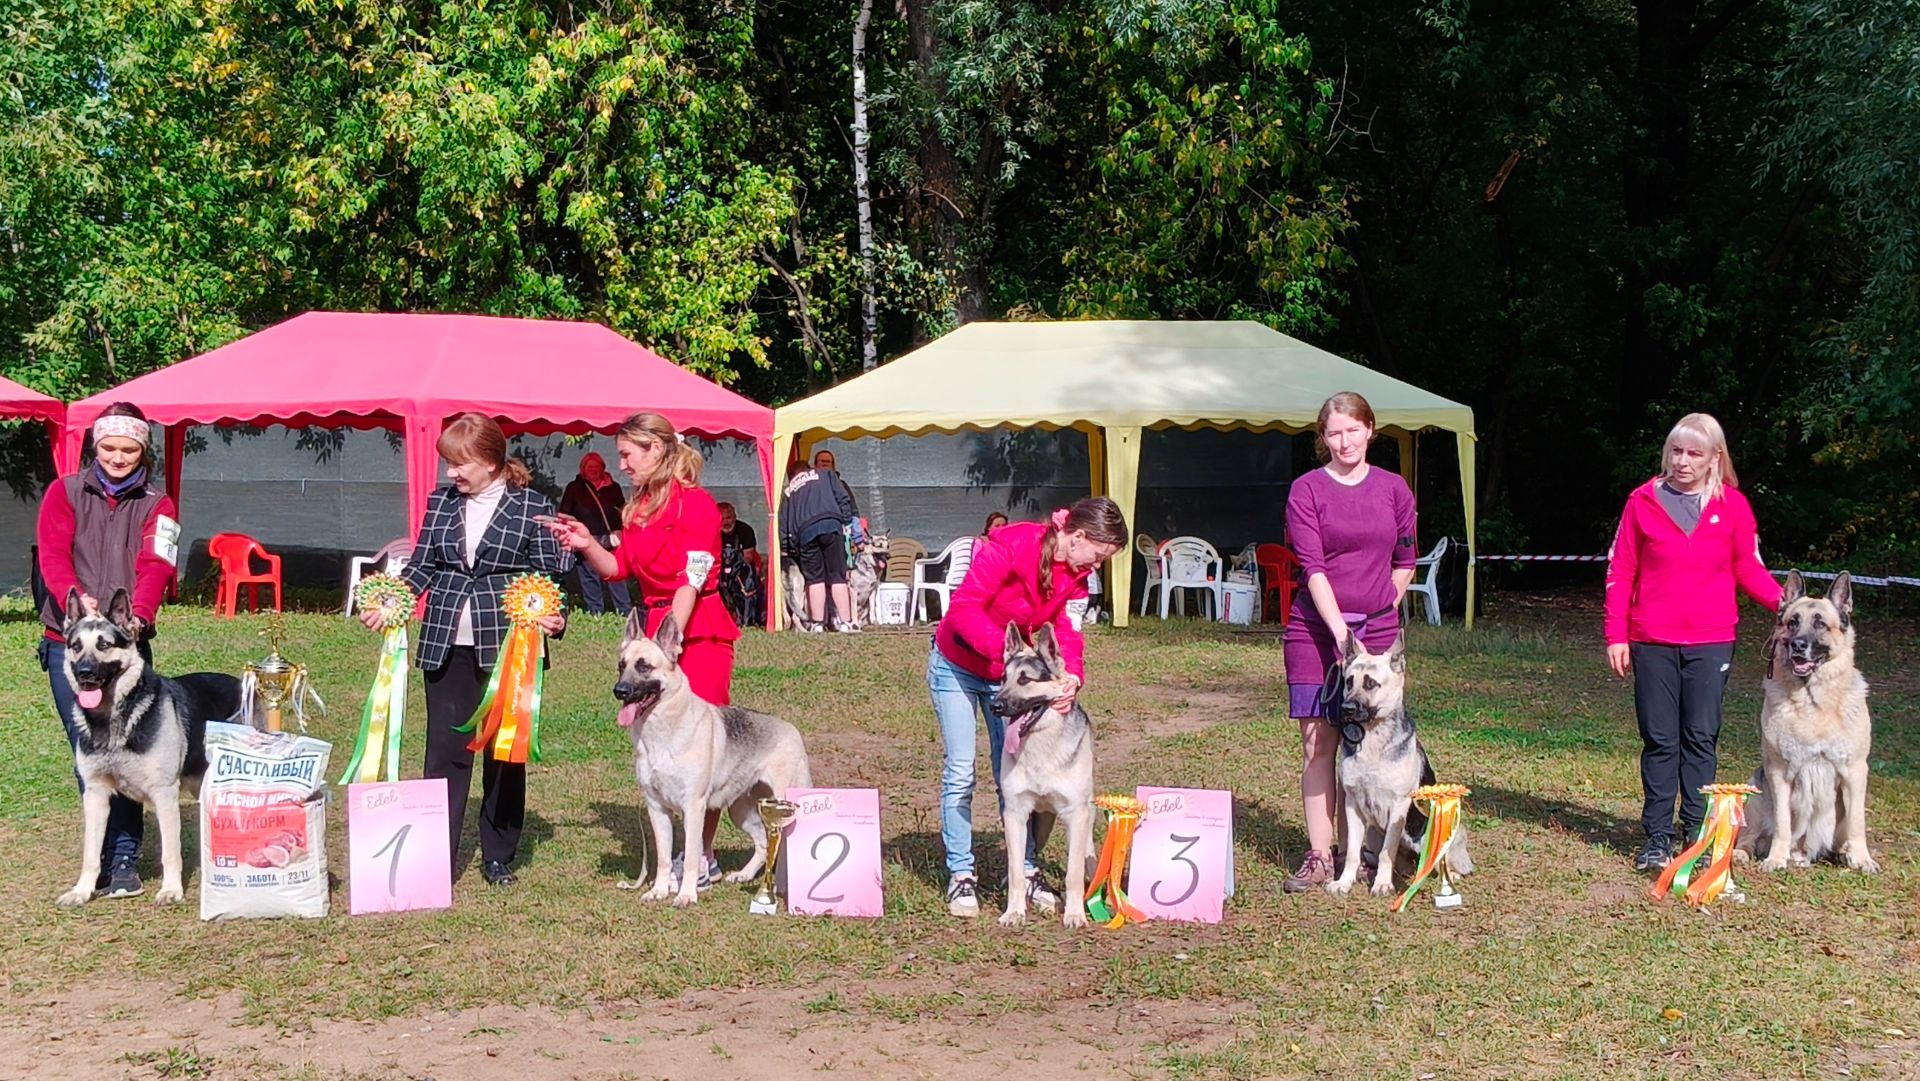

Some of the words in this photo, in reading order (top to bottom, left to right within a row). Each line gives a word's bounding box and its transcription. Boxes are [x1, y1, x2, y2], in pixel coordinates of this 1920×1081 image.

[217, 754, 316, 783] СЧАСТЛИВЫЙ
[216, 792, 266, 808] МЯСНОЙ
[252, 815, 286, 829] КОРМ
[372, 824, 412, 897] 1
[807, 832, 850, 903] 2
[1150, 833, 1200, 906] 3
[213, 873, 235, 883] 100%
[246, 873, 277, 883] ЗАБОТА
